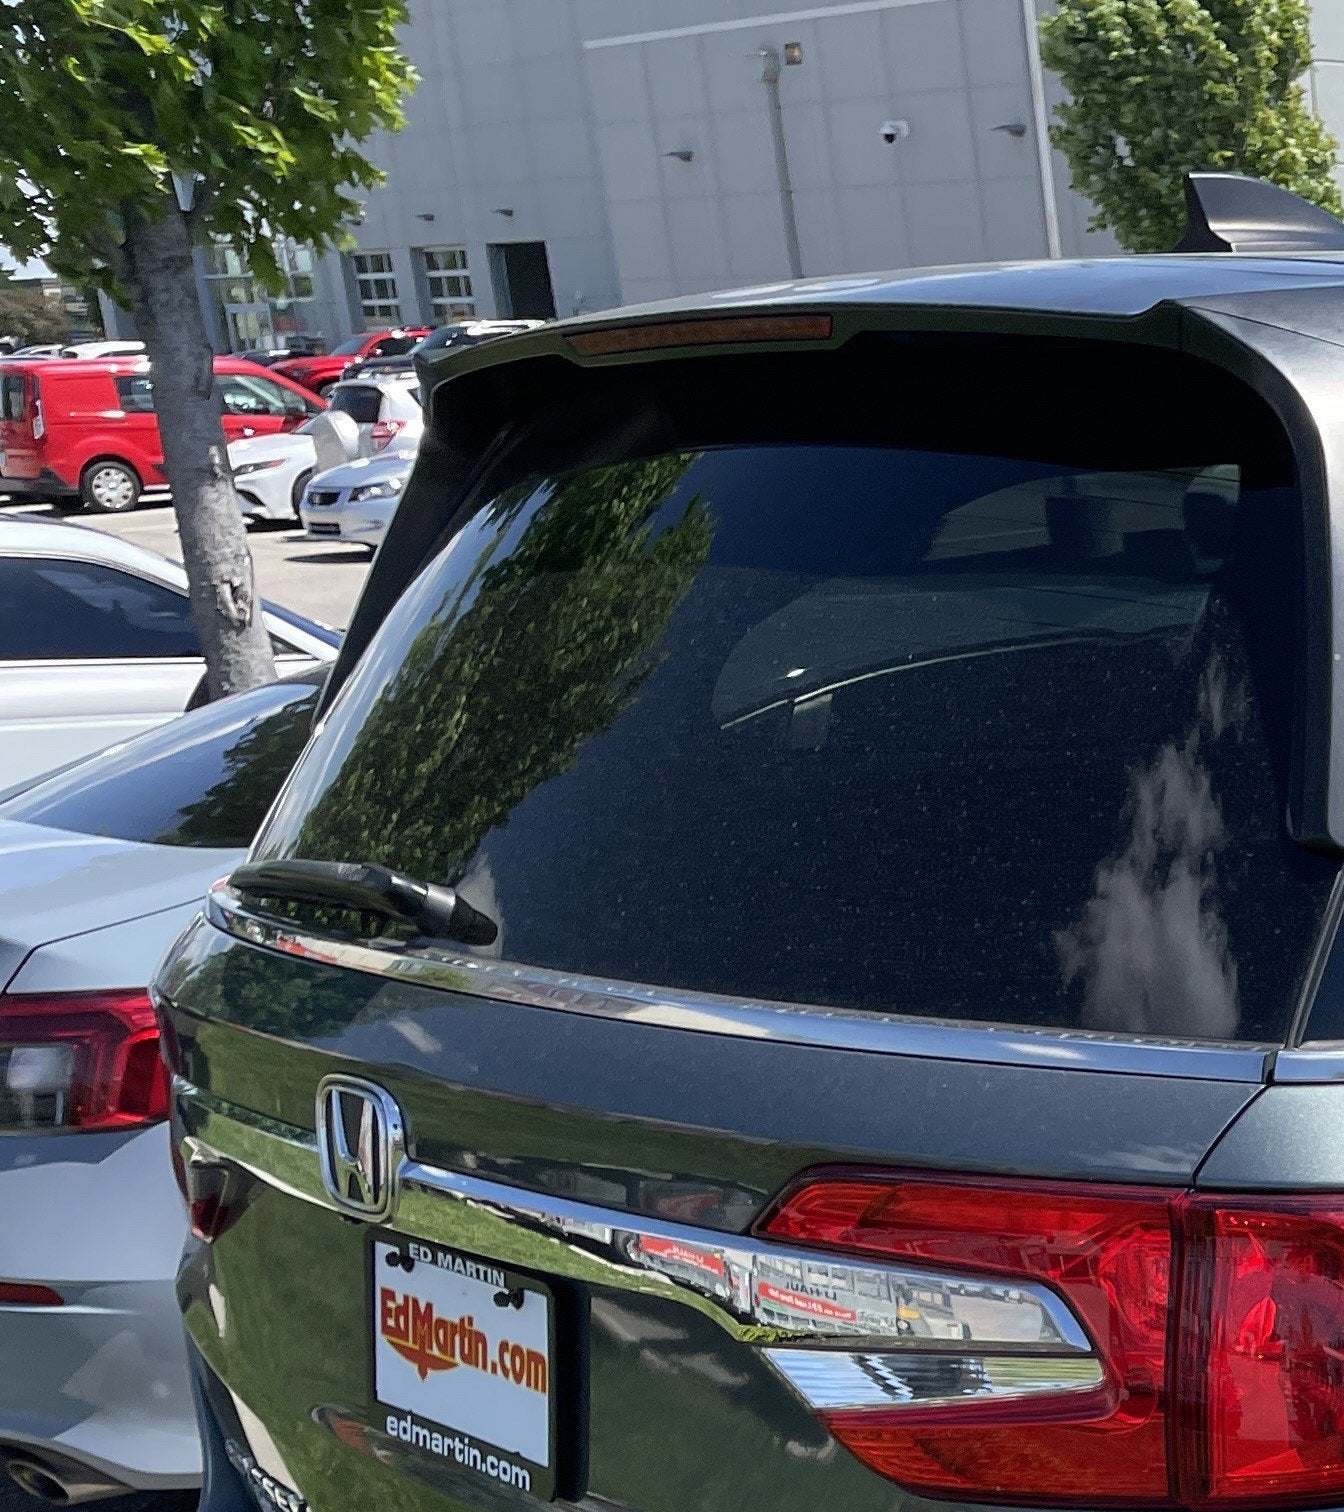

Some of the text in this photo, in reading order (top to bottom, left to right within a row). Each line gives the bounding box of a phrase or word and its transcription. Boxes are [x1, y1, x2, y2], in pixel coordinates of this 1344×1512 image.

[408, 1243, 506, 1289] ED MARTIN
[386, 1414, 531, 1492] edmartin.com
